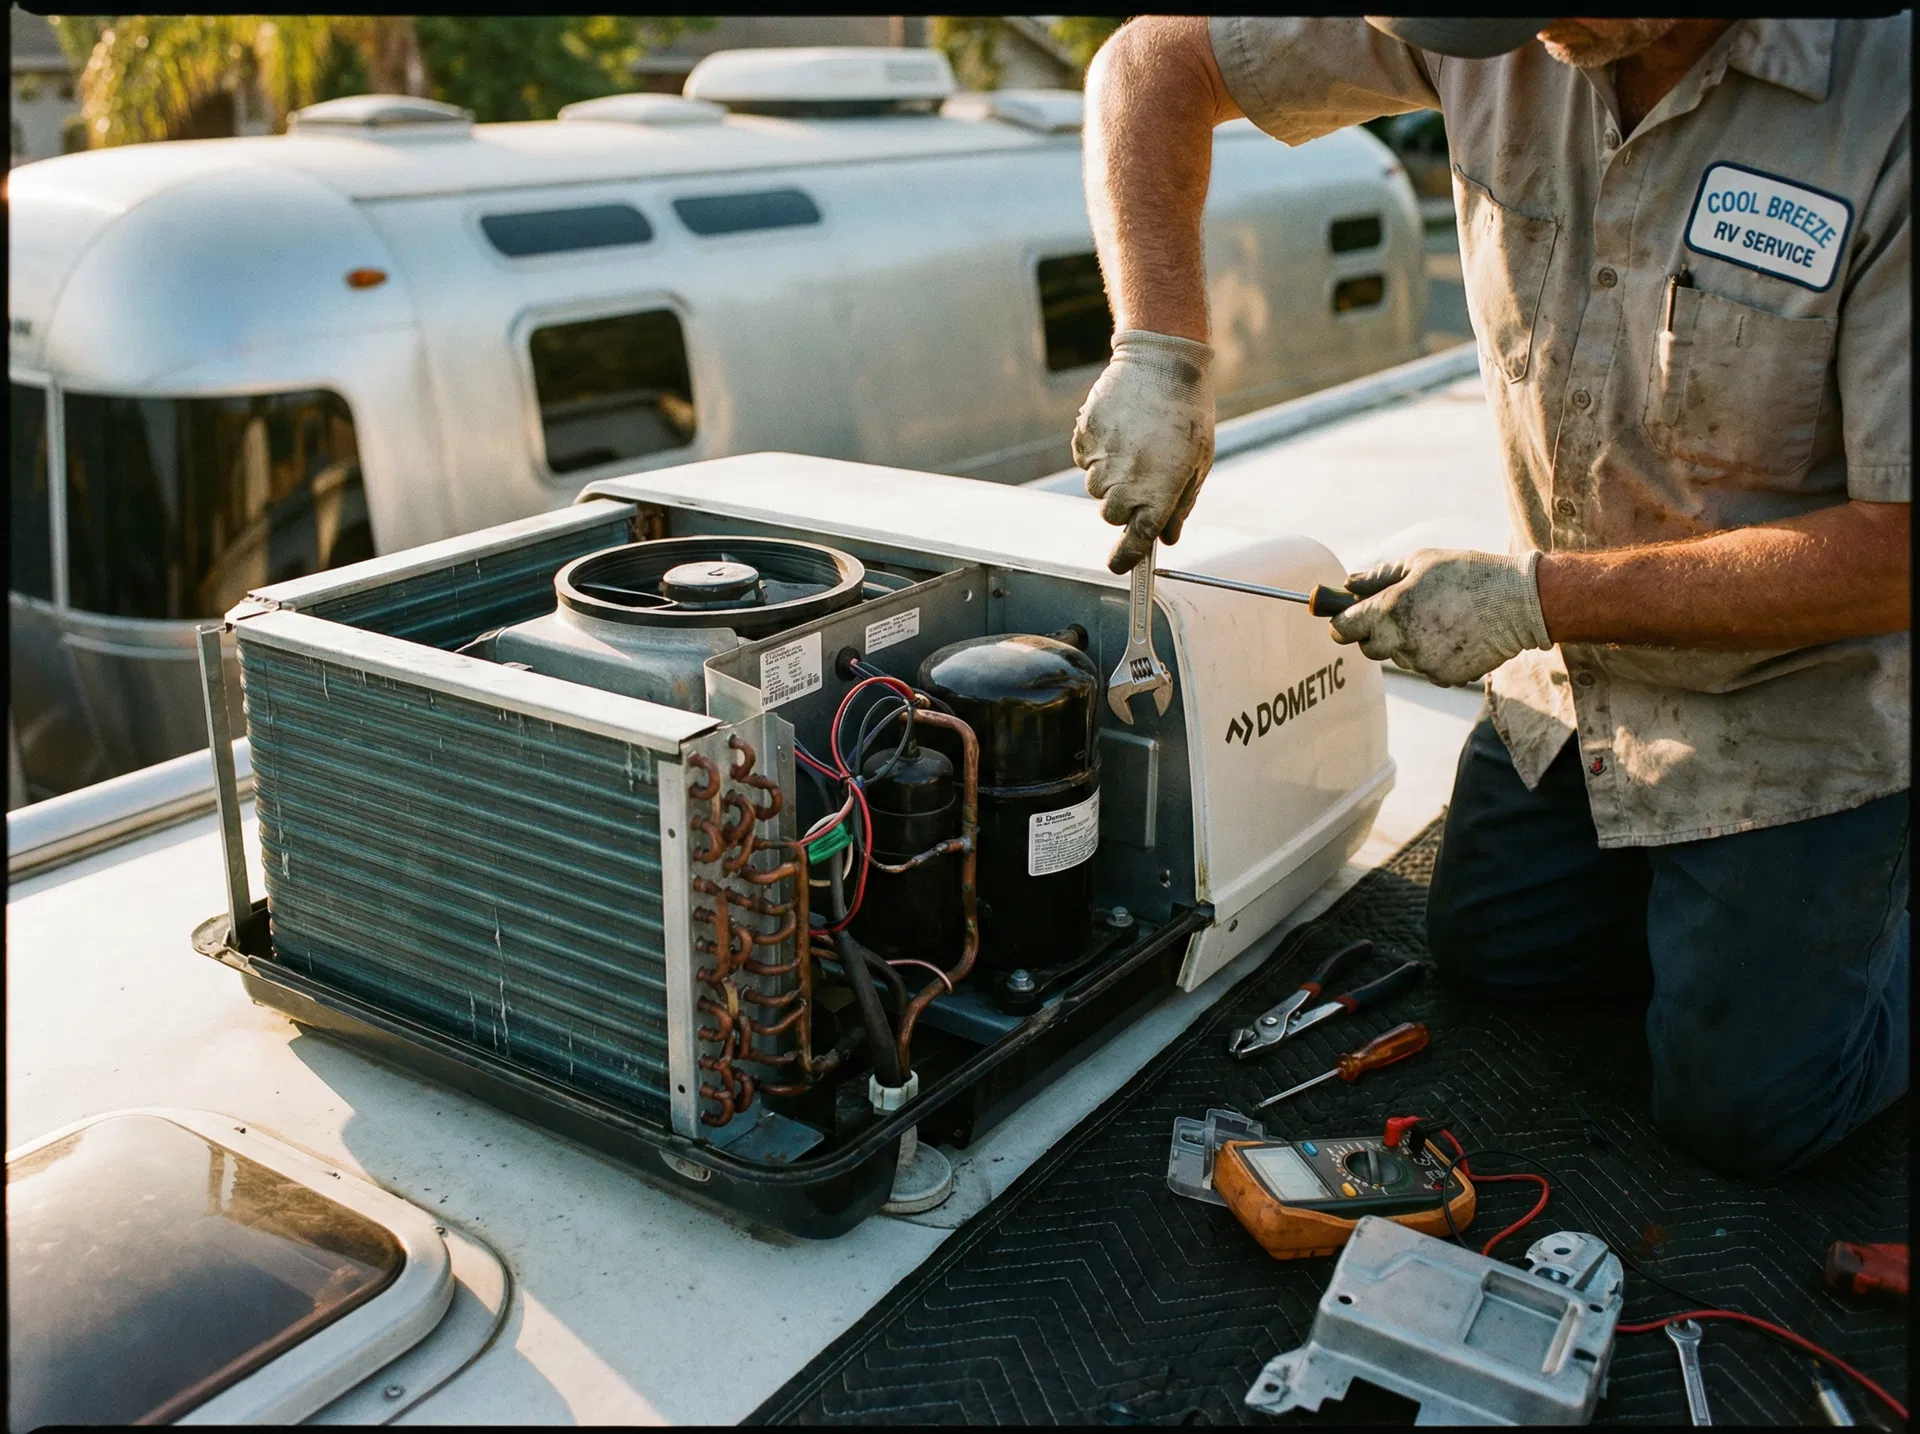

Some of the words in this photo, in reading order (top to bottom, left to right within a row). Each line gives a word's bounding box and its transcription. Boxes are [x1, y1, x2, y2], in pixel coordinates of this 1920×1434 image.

[1707, 191, 1760, 214] COOL
[1766, 196, 1837, 249] BREEZE
[1713, 221, 1741, 243] RV
[1742, 229, 1816, 268] SERVICE
[1256, 657, 1346, 738] DOMETIC
